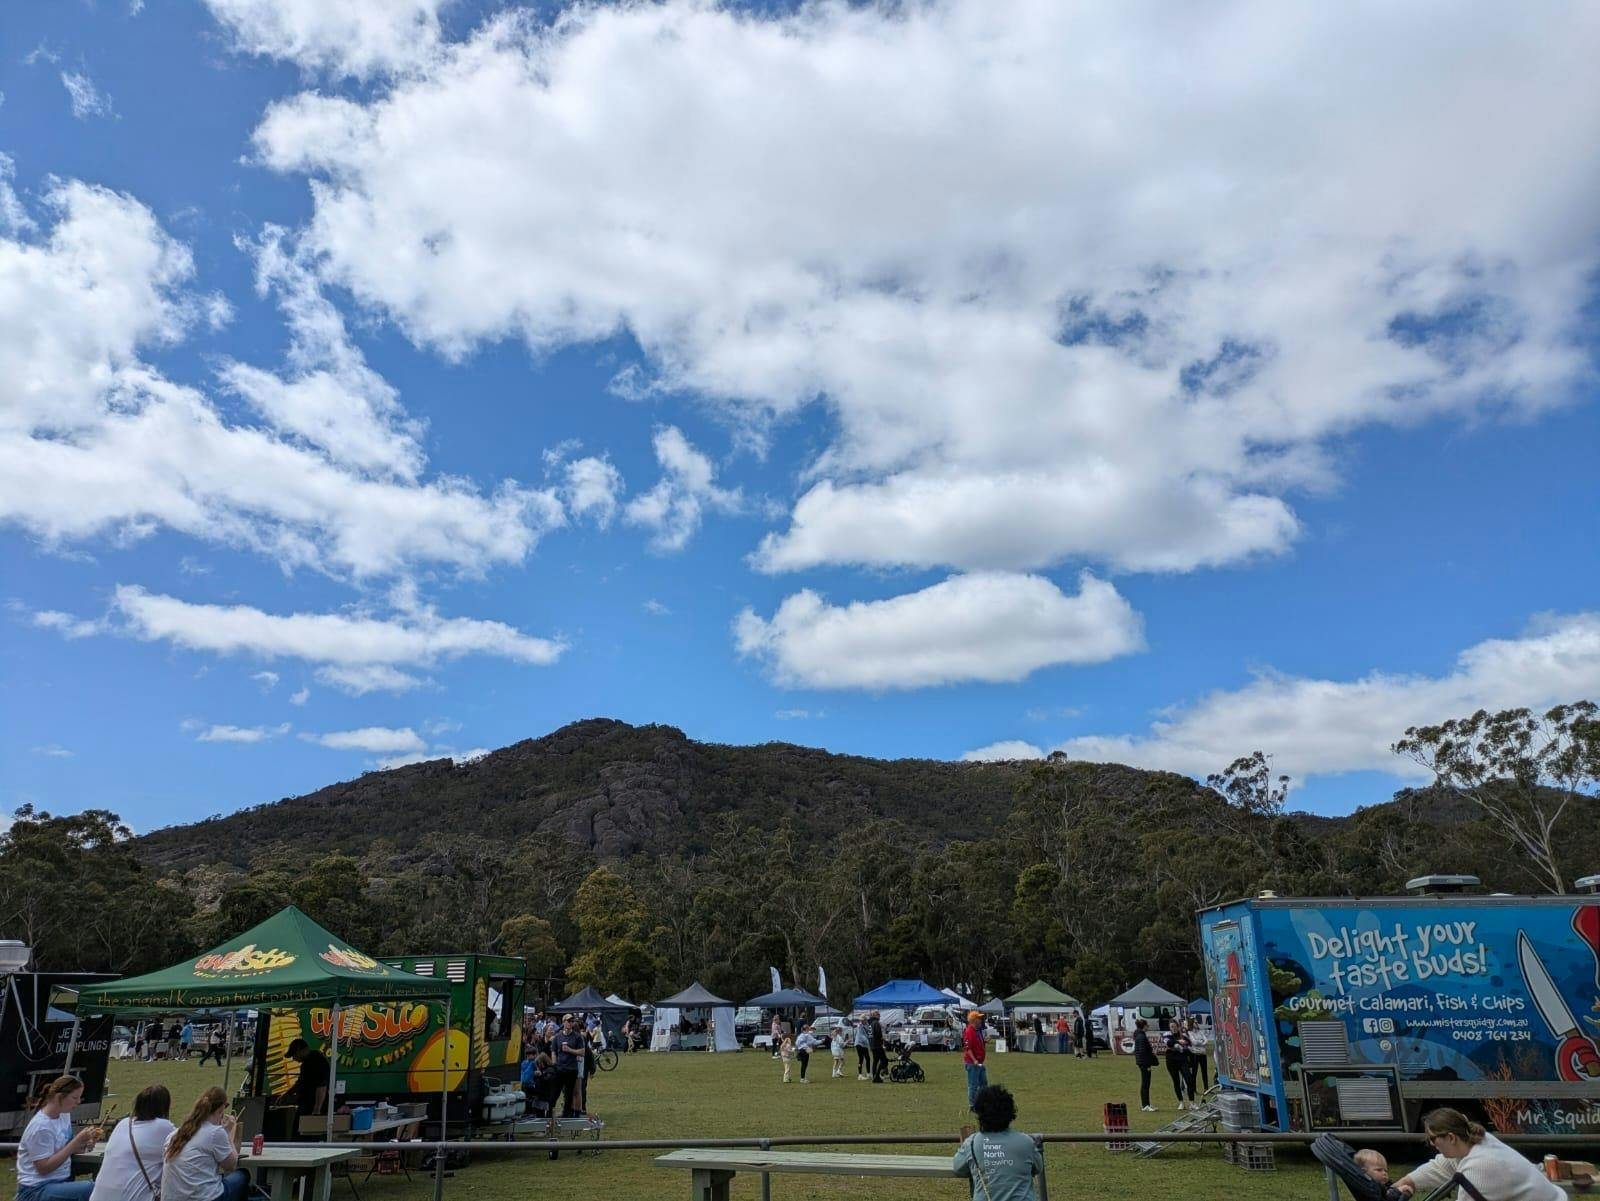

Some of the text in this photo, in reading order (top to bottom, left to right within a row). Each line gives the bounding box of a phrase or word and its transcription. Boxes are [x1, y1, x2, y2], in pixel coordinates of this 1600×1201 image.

[1308, 921, 1476, 962] Delight your
[1329, 943, 1487, 995] taste buds!
[98, 992, 119, 1007] the
[124, 990, 173, 1008] original
[234, 991, 265, 1004] twist
[270, 988, 319, 1004] potato
[1289, 995, 1355, 1015] Gourmet
[1360, 993, 1433, 1012] Calamari,
[1483, 994, 1525, 1013] Chips
[1452, 1030, 1531, 1041] 0408 764 234
[1517, 1109, 1547, 1125] Mr.
